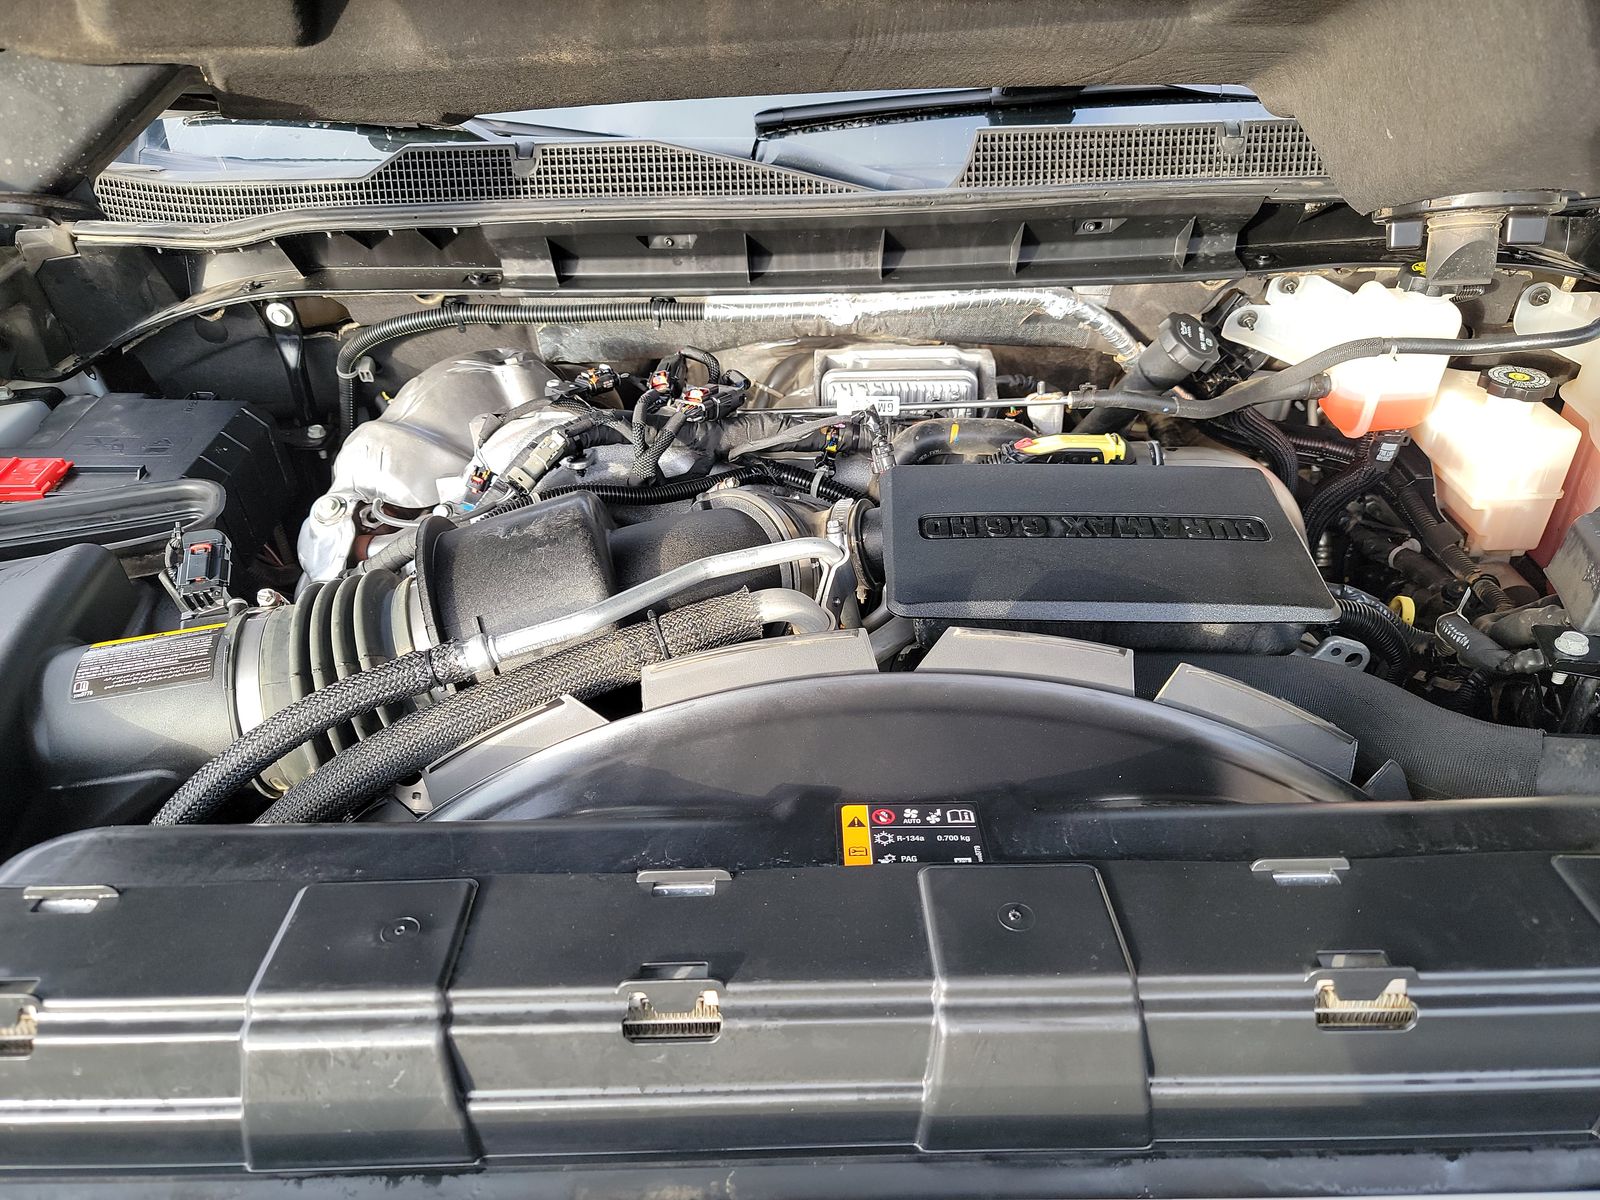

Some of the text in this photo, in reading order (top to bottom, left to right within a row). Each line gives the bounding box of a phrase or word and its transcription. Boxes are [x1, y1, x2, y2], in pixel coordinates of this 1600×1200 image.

[877, 402, 894, 413] GM
[924, 515, 1270, 541] DURAMAX 6.6 HD
[960, 834, 971, 842] kg
